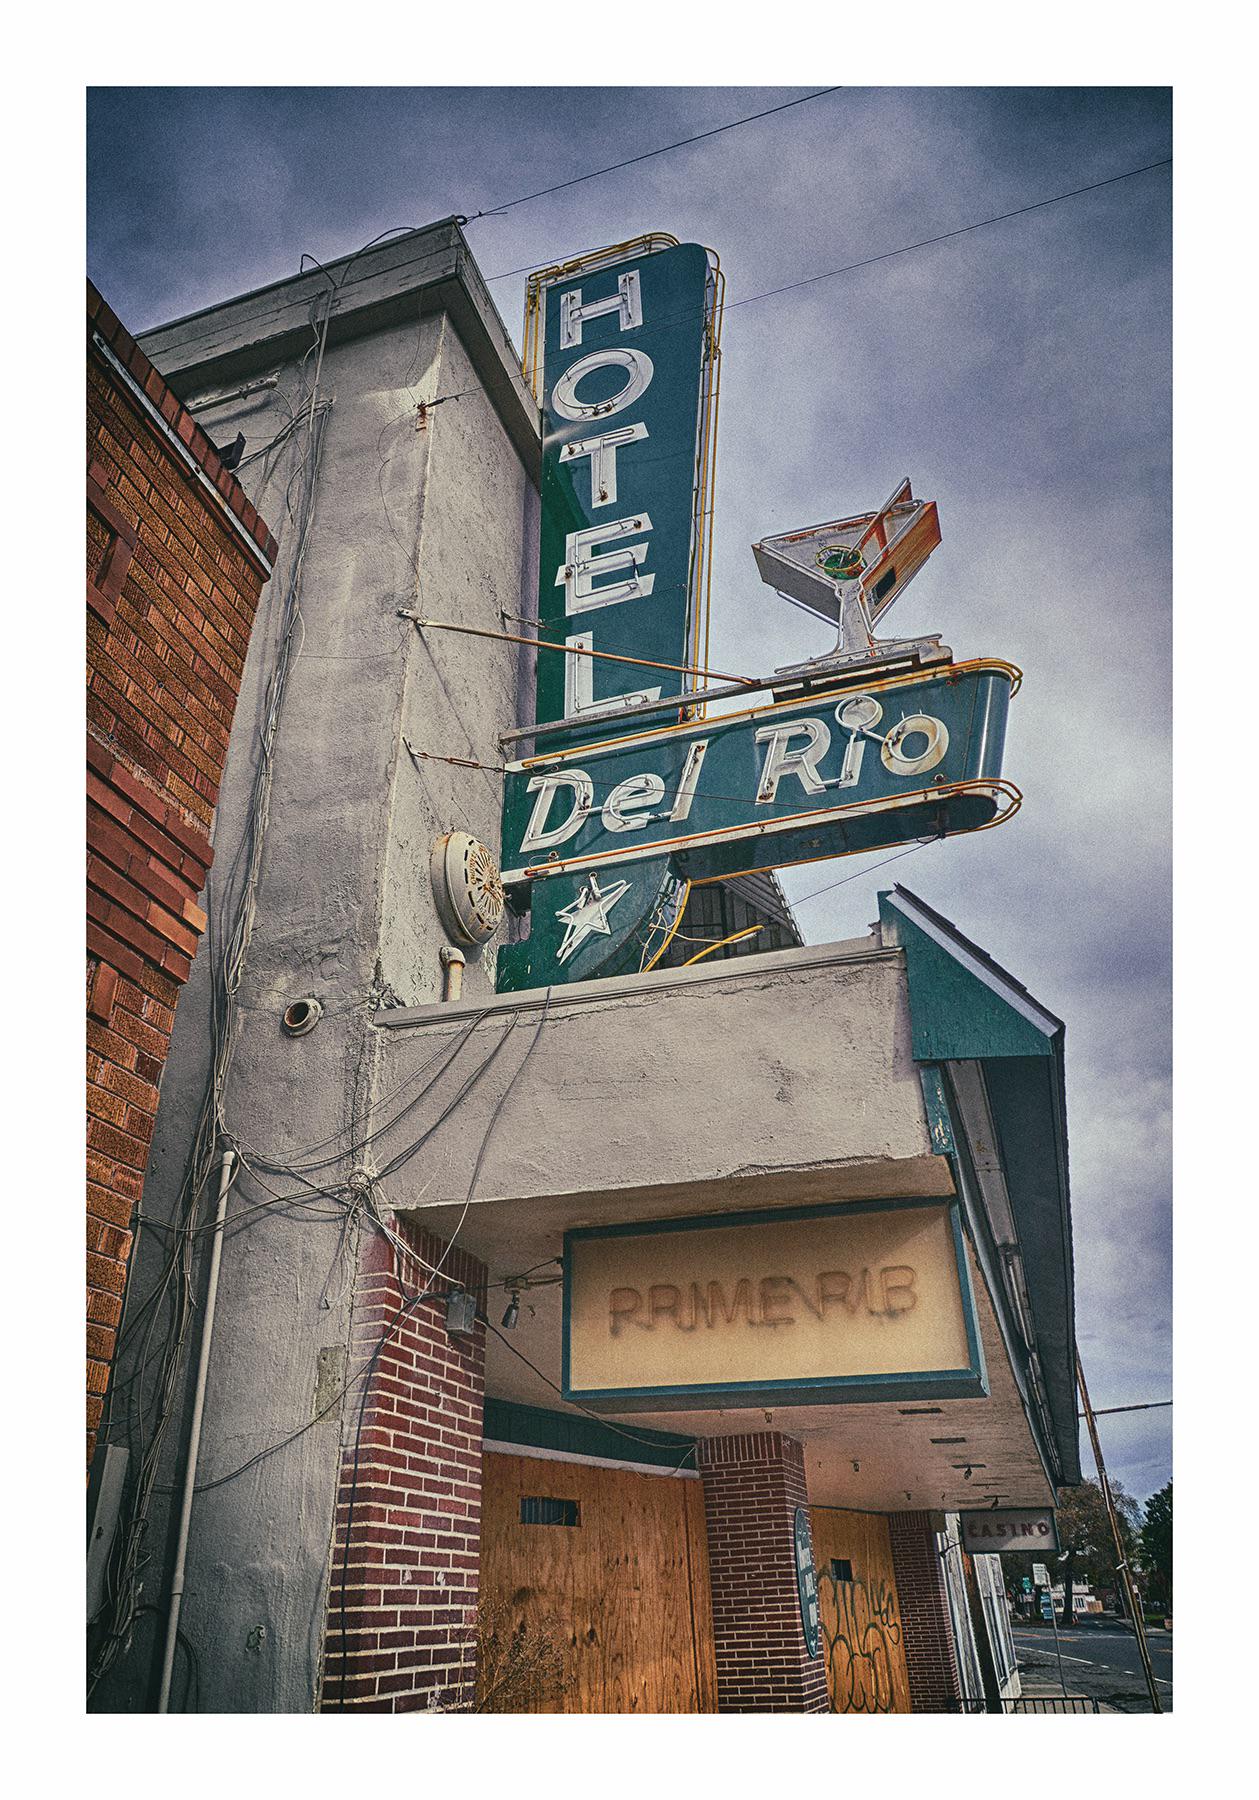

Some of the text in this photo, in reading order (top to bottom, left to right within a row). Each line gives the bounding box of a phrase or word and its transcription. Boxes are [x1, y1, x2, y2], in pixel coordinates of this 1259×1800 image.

[552, 269, 662, 720] HOTEL
[519, 695, 950, 853] Del Rio
[609, 1265, 918, 1336] PRIME RIB
[967, 1522, 1050, 1537] CASINO
